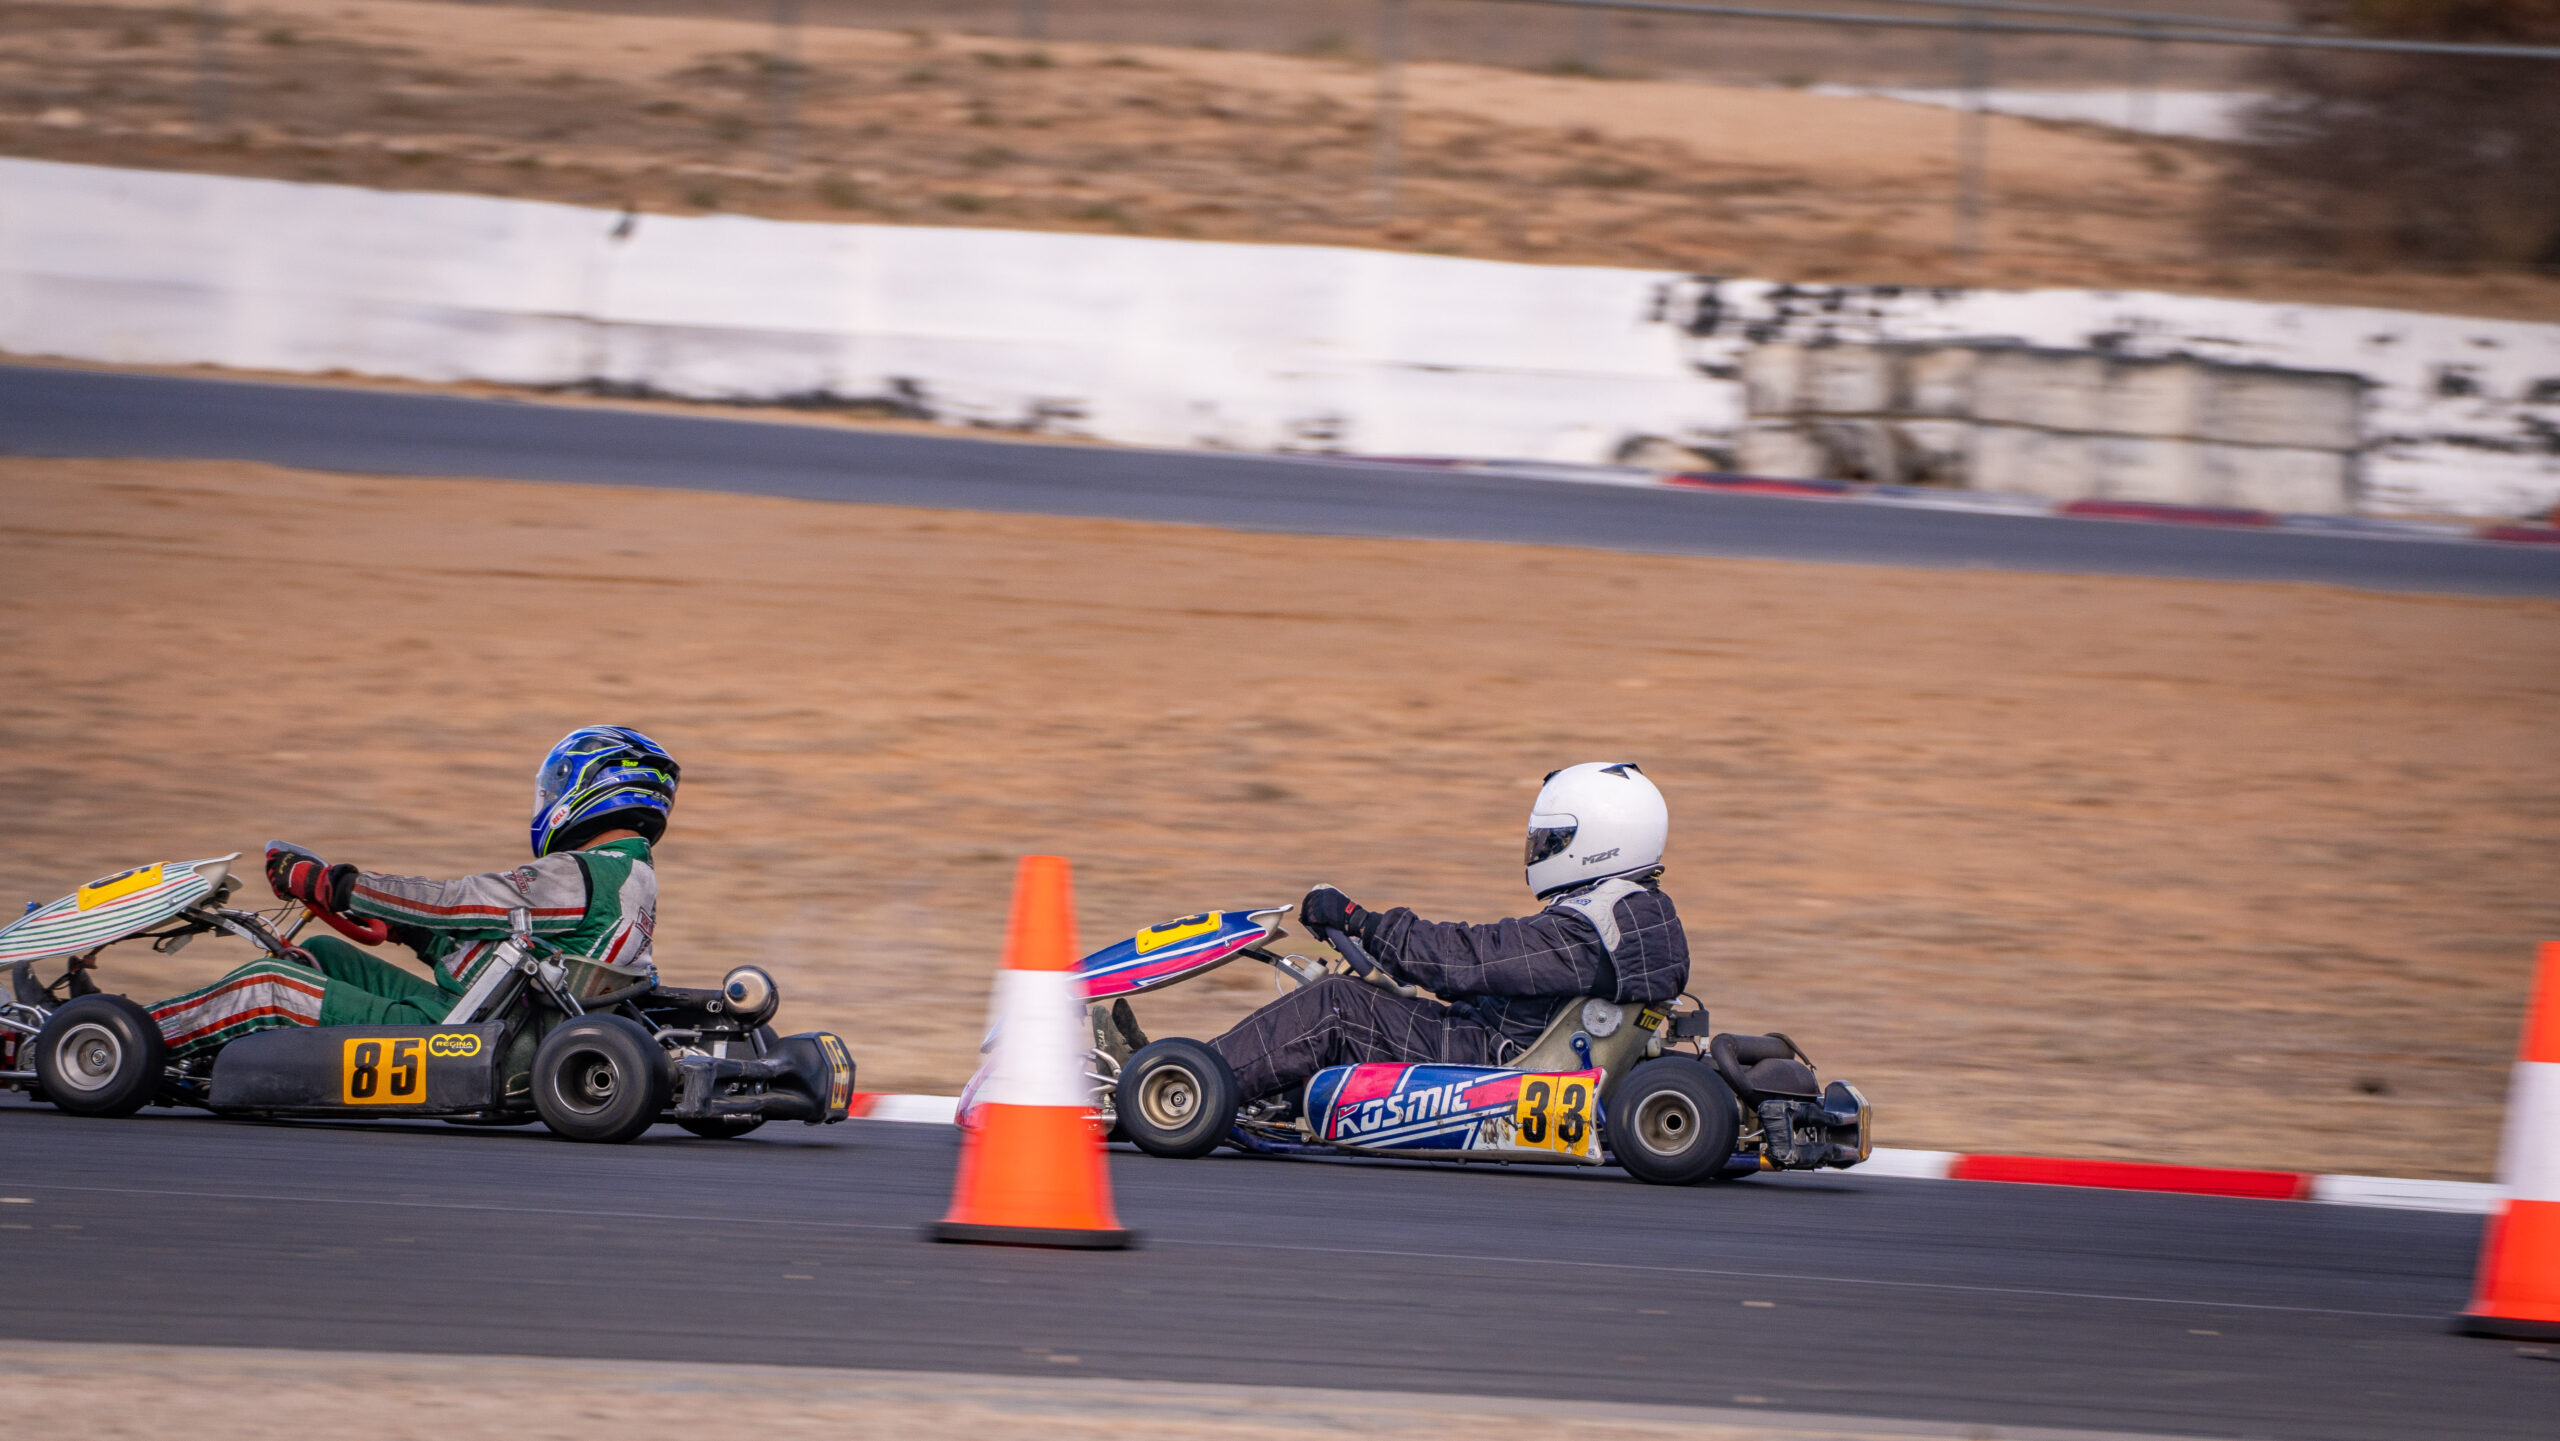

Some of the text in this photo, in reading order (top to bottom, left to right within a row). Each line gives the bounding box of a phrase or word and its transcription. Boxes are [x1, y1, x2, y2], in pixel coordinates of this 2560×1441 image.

[551, 808, 567, 826] BELL
[1581, 847, 1620, 866] MZR
[435, 1040, 473, 1048] REGINA
[351, 1039, 421, 1099] 85
[1335, 1080, 1473, 1138] KOSMIC
[1522, 1080, 1588, 1144] 33
